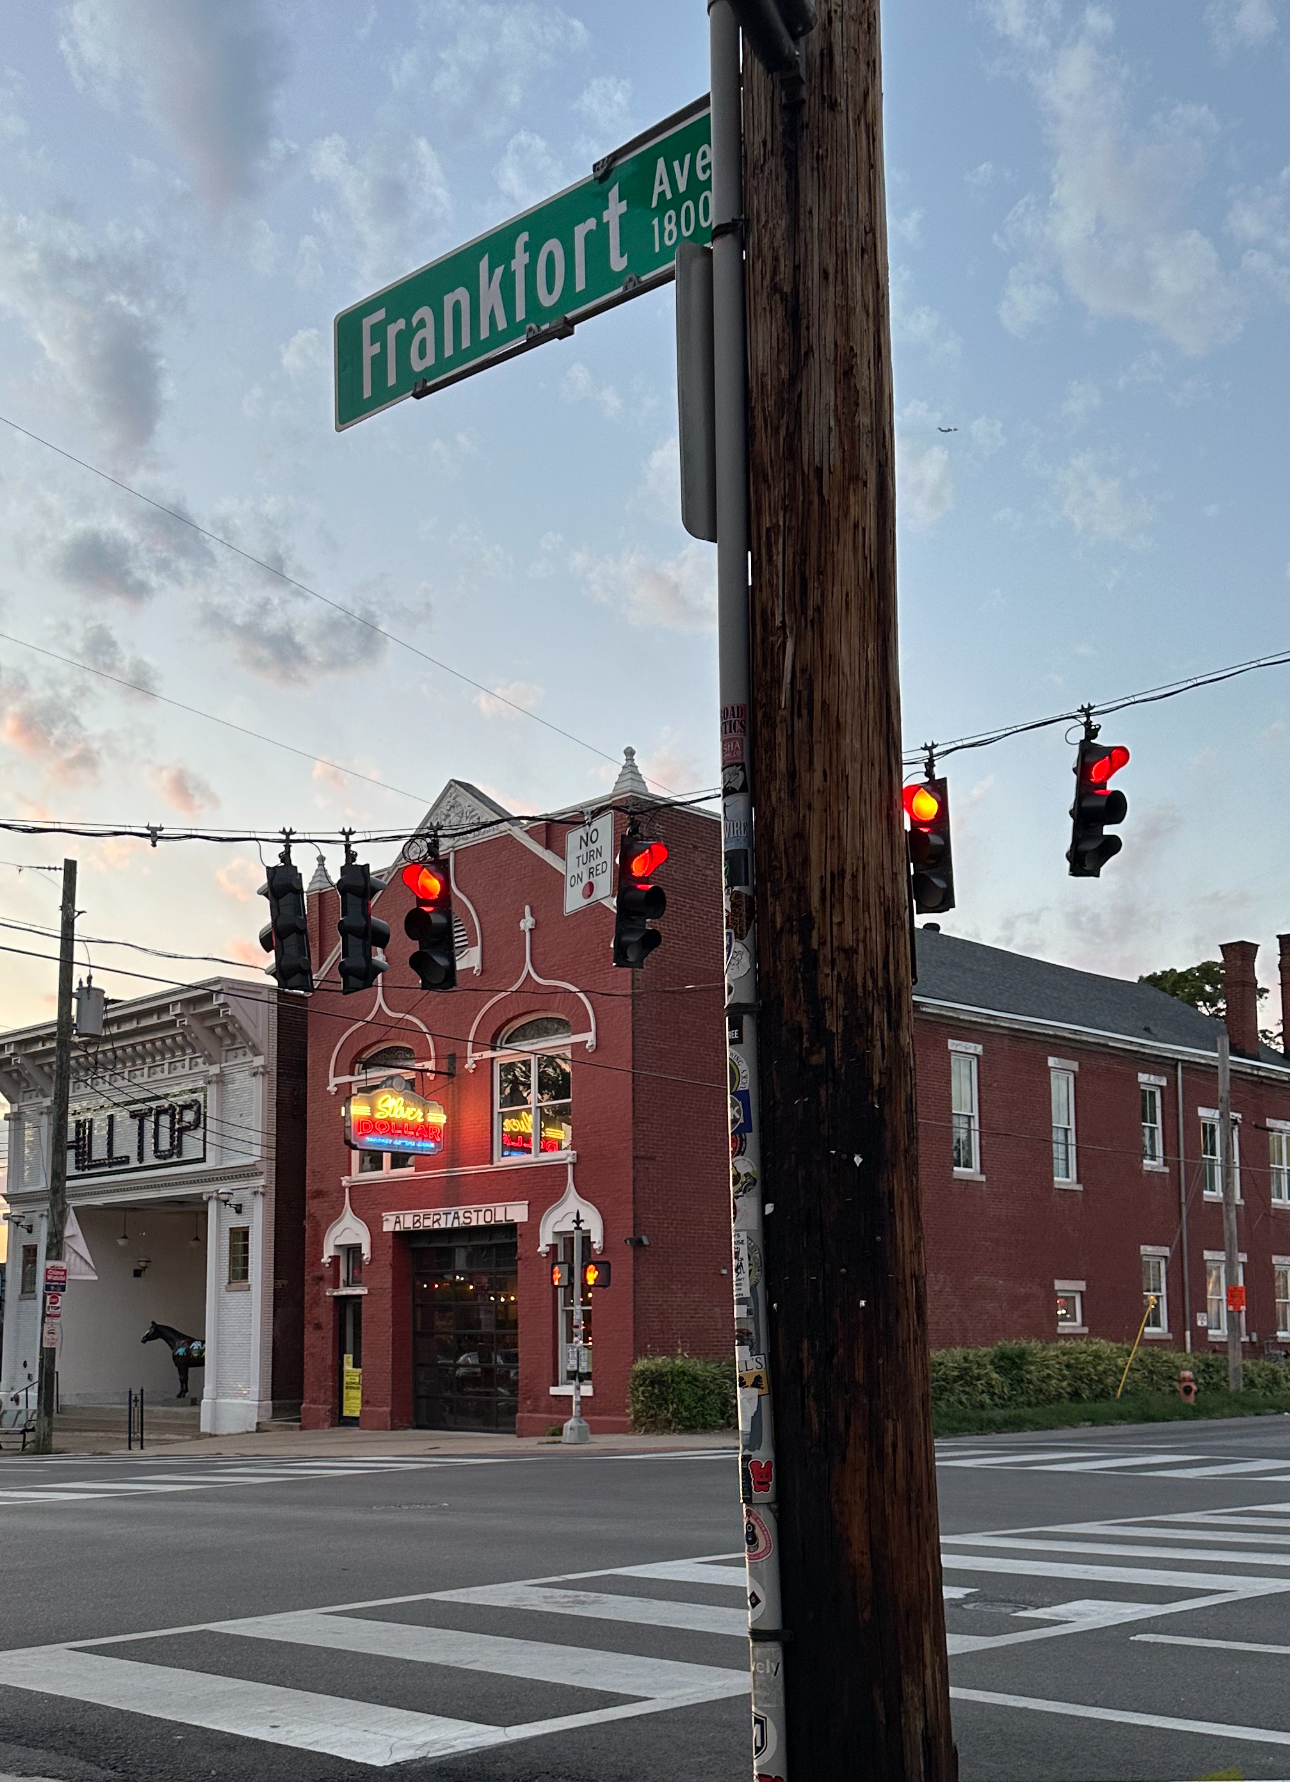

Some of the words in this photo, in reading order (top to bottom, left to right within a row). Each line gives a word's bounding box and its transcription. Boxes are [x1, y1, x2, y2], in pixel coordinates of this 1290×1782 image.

[650, 143, 712, 208] Ave
[651, 190, 713, 253] 1800
[362, 181, 628, 399] Frankfort
[721, 705, 743, 720] OAD
[721, 720, 746, 734] TICS
[579, 828, 599, 850] NO
[576, 845, 603, 868] TURN
[569, 871, 584, 888] ON
[588, 860, 608, 881] RED
[375, 1094, 425, 1122] Silver
[357, 1119, 441, 1142] DOLLAR
[752, 1658, 780, 1678] ely
